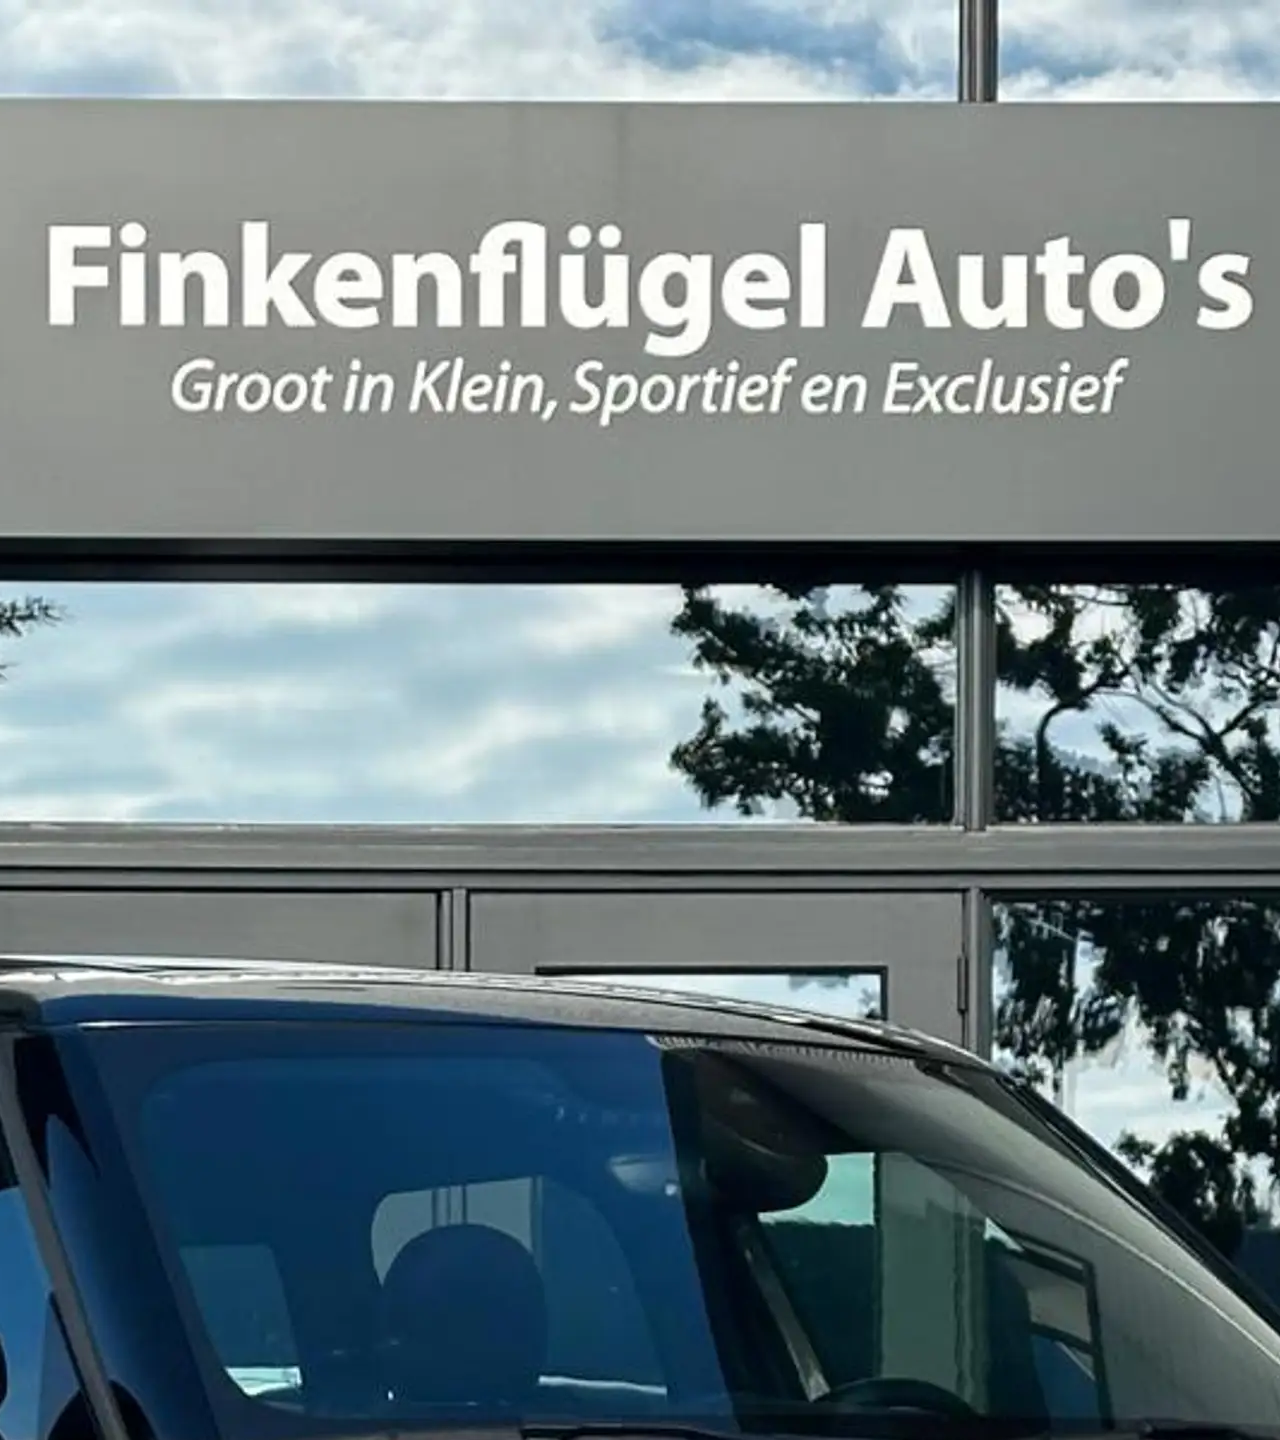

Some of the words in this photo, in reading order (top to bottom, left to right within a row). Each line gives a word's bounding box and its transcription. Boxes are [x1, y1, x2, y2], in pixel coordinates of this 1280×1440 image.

[49, 221, 826, 357] Finkenflügel
[861, 219, 1253, 330] Auto's
[171, 358, 334, 413] Groot
[343, 359, 394, 413] in
[409, 356, 558, 421] Klein,
[569, 357, 798, 428] Sportief
[801, 374, 867, 414] en
[883, 357, 1129, 414] Exclusief
